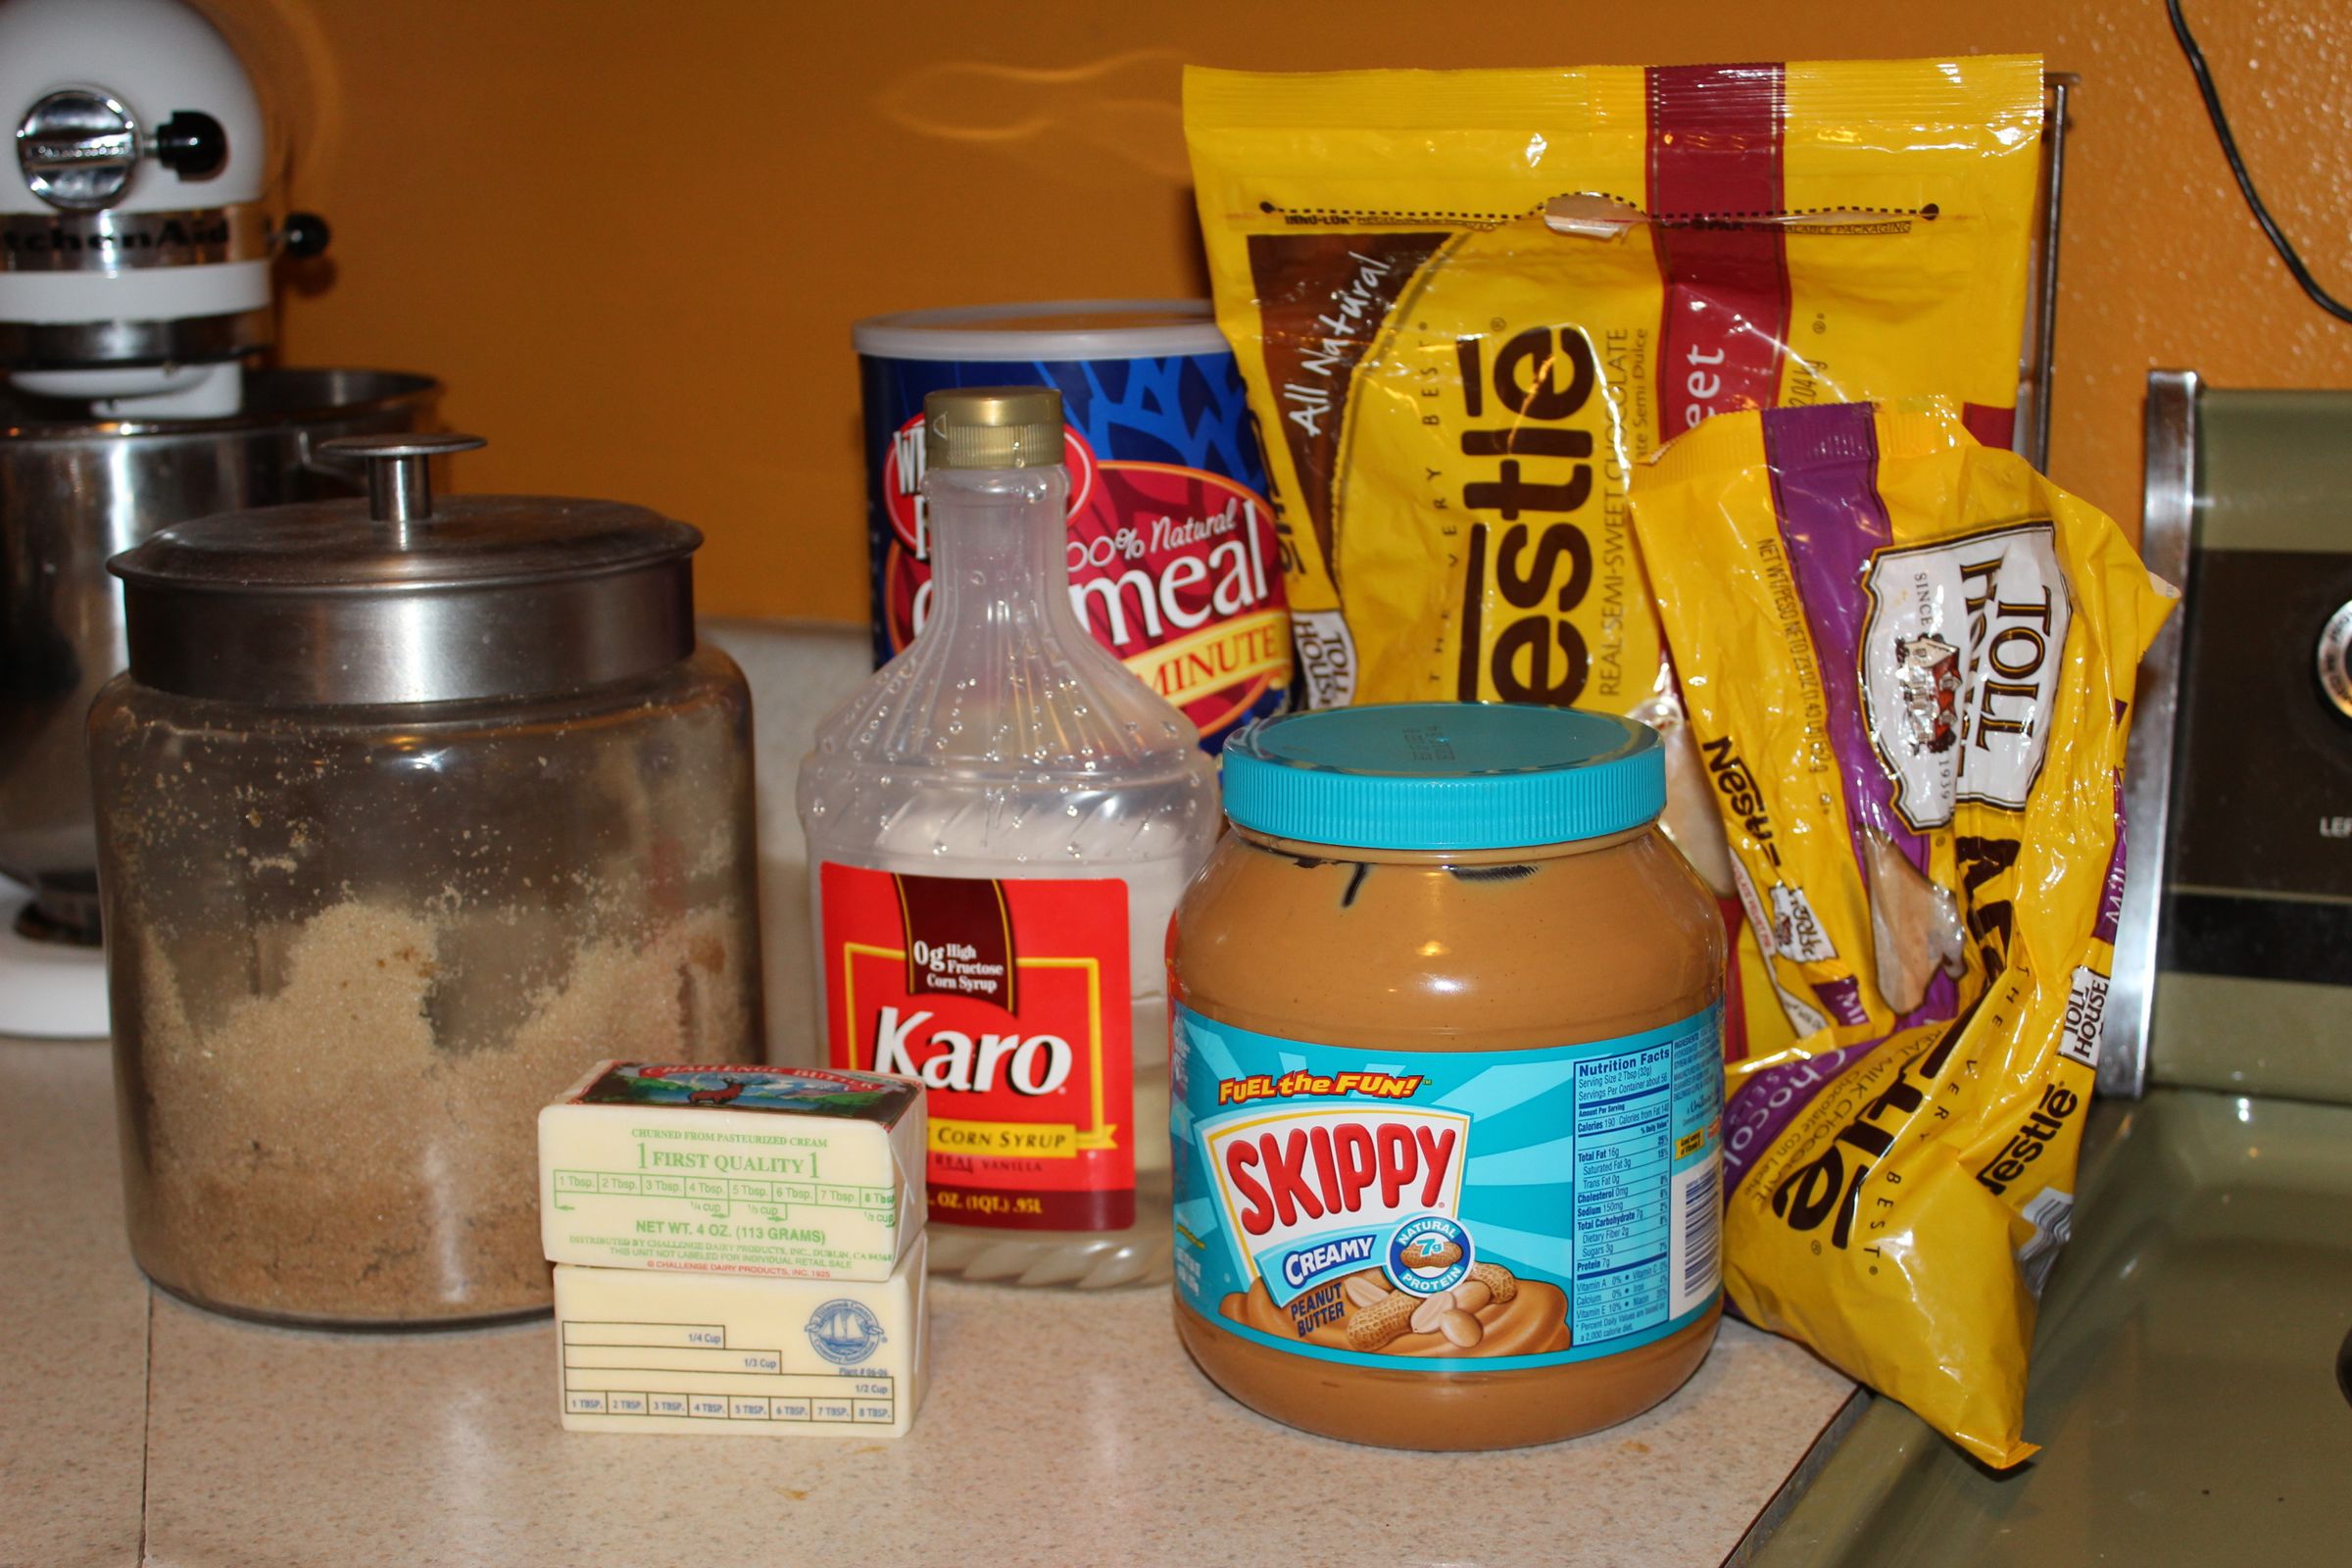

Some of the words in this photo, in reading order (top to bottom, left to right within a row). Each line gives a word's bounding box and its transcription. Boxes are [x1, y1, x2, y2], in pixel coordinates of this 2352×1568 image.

[1298, 250, 1392, 376] Natural
[1283, 383, 1331, 437] All
[1066, 528, 1147, 572] 00%
[1150, 498, 1237, 553] Natural
[1914, 572, 1933, 626] SINCE
[1599, 638, 1622, 697] REAL
[1976, 585, 2052, 752] TOLL
[1938, 760, 1951, 800] 1939
[913, 940, 945, 972] 0g
[946, 943, 976, 961] High
[947, 960, 1004, 976] Fructose
[927, 973, 957, 989] Corn
[958, 975, 998, 995] Syrup
[2064, 986, 2090, 1035] TOLL
[2073, 979, 2109, 1059] HOUSE
[873, 1004, 1073, 1096] Karo
[1579, 1058, 1637, 1077] Nutrition
[1641, 1049, 1670, 1065] Facts
[1219, 1074, 1275, 1104] FUEL
[1279, 1069, 1331, 1098] the
[1334, 1072, 1423, 1098] FUN!
[1579, 1077, 1602, 1088] Serving
[1604, 1074, 1616, 1083] Size
[1624, 1070, 1637, 1081] Tbsp
[1638, 1066, 1652, 1078] (32g)
[1579, 1090, 1606, 1101] Servings
[1619, 1081, 1645, 1093] Container
[1607, 1103, 1625, 1113] Serving
[1578, 1121, 1603, 1132] Calories
[1605, 1118, 1615, 1128] 190
[1619, 1112, 1640, 1125] Calories
[631, 1128, 681, 1139] CHURNED
[684, 1131, 714, 1142] FROM
[716, 1133, 787, 1145] PASTEURIZED
[789, 1137, 827, 1148] CREAM
[937, 1126, 991, 1147] CORN
[998, 1130, 1067, 1149] SYRUP
[652, 1151, 710, 1170] FIRST
[714, 1153, 805, 1174] QUALITY
[935, 1154, 973, 1172] REAL
[981, 1158, 1043, 1172] VANILLA
[1579, 1152, 1594, 1161] Total
[1596, 1150, 1606, 1158] Fat
[1584, 1162, 1613, 1175] Saturated
[1614, 1160, 1623, 1169] Fat
[1226, 1122, 1457, 1237] SKIPPY
[1584, 1179, 1600, 1189] Trans
[1578, 1189, 1614, 1203] Cholesterol
[702, 1202, 721, 1213] cup
[760, 1206, 779, 1217] cup
[1578, 1206, 1601, 1217] Sodium
[1603, 1201, 1623, 1212] 150mg
[1578, 1220, 1593, 1230] Total
[1595, 1211, 1636, 1228] Carbohydrate
[636, 1220, 665, 1235] NET
[668, 1222, 692, 1236] WT.
[696, 1223, 706, 1236] 4
[709, 1223, 732, 1238] OZ.
[736, 1226, 764, 1242] (113
[767, 1227, 826, 1246] GRAMS)
[1397, 1219, 1458, 1246] NATURAL
[1583, 1233, 1604, 1244] Dietary
[1606, 1229, 1620, 1239] Fiber
[568, 1236, 630, 1247] DISTRIBUTED
[632, 1239, 646, 1248] BY
[647, 1240, 705, 1250] CHALLENGE
[706, 1243, 734, 1252] DAIRY
[853, 1251, 867, 1260] CA
[1416, 1237, 1444, 1257] 7g
[1583, 1247, 1603, 1257] Sugars
[610, 1247, 630, 1256] THIS
[633, 1248, 655, 1257] UNIT
[657, 1250, 676, 1258] NOT
[677, 1250, 719, 1261] LABELED
[720, 1252, 739, 1261] FOR
[742, 1254, 792, 1265] INDIVIDUAL
[795, 1257, 826, 1267] RETAIL
[828, 1259, 853, 1269] SALE
[656, 1261, 709, 1271] CHALLENGE
[710, 1263, 736, 1272] DAIRY
[1285, 1237, 1374, 1287] CREAMY
[1577, 1260, 1600, 1271] Protein
[1401, 1265, 1462, 1291] PROTEIN
[1577, 1281, 1600, 1292] Vitamin
[1291, 1282, 1343, 1321] PEANUT
[1577, 1296, 1601, 1305] Calcium
[1297, 1301, 1345, 1339] BUTTER
[1577, 1308, 1600, 1319] Vitamin
[1582, 1321, 1602, 1331] Percent
[688, 1332, 703, 1344] 1/4
[705, 1333, 721, 1345] Cup
[744, 1357, 759, 1369] 1/3
[760, 1358, 777, 1370] Cup
[855, 1383, 869, 1394] 1/2
[870, 1384, 888, 1396] Cup
